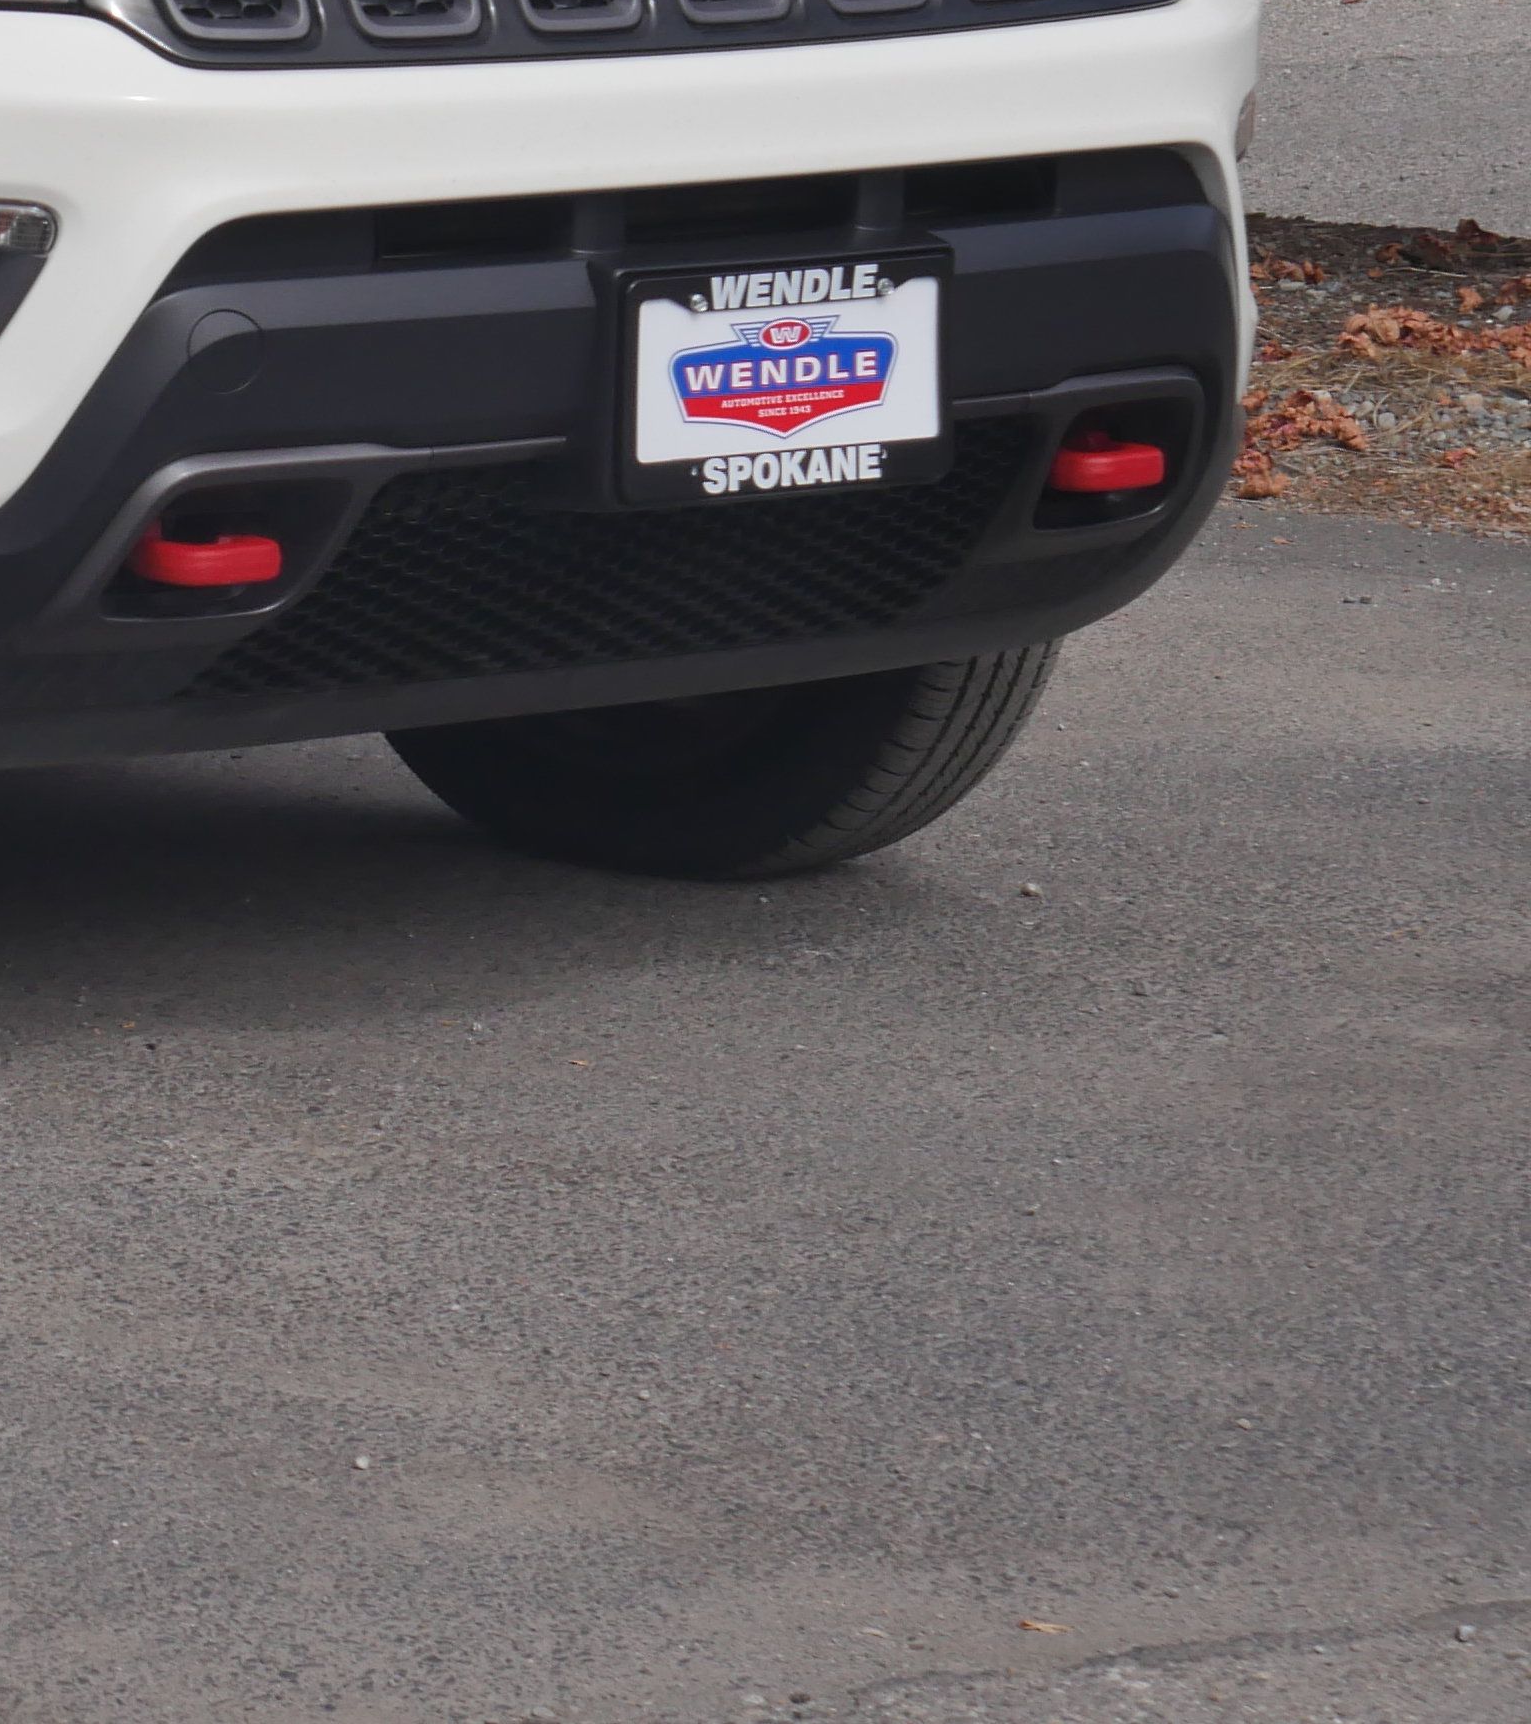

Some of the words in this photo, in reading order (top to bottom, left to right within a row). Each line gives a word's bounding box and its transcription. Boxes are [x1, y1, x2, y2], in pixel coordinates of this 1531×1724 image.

[710, 263, 879, 310] WENDLE
[686, 350, 877, 391] WENDLE
[721, 395, 783, 408] AUTOMOTIVE
[785, 390, 845, 403] EXCELLENCE
[758, 407, 787, 417] SINCE
[702, 443, 882, 495] SPOKANE
